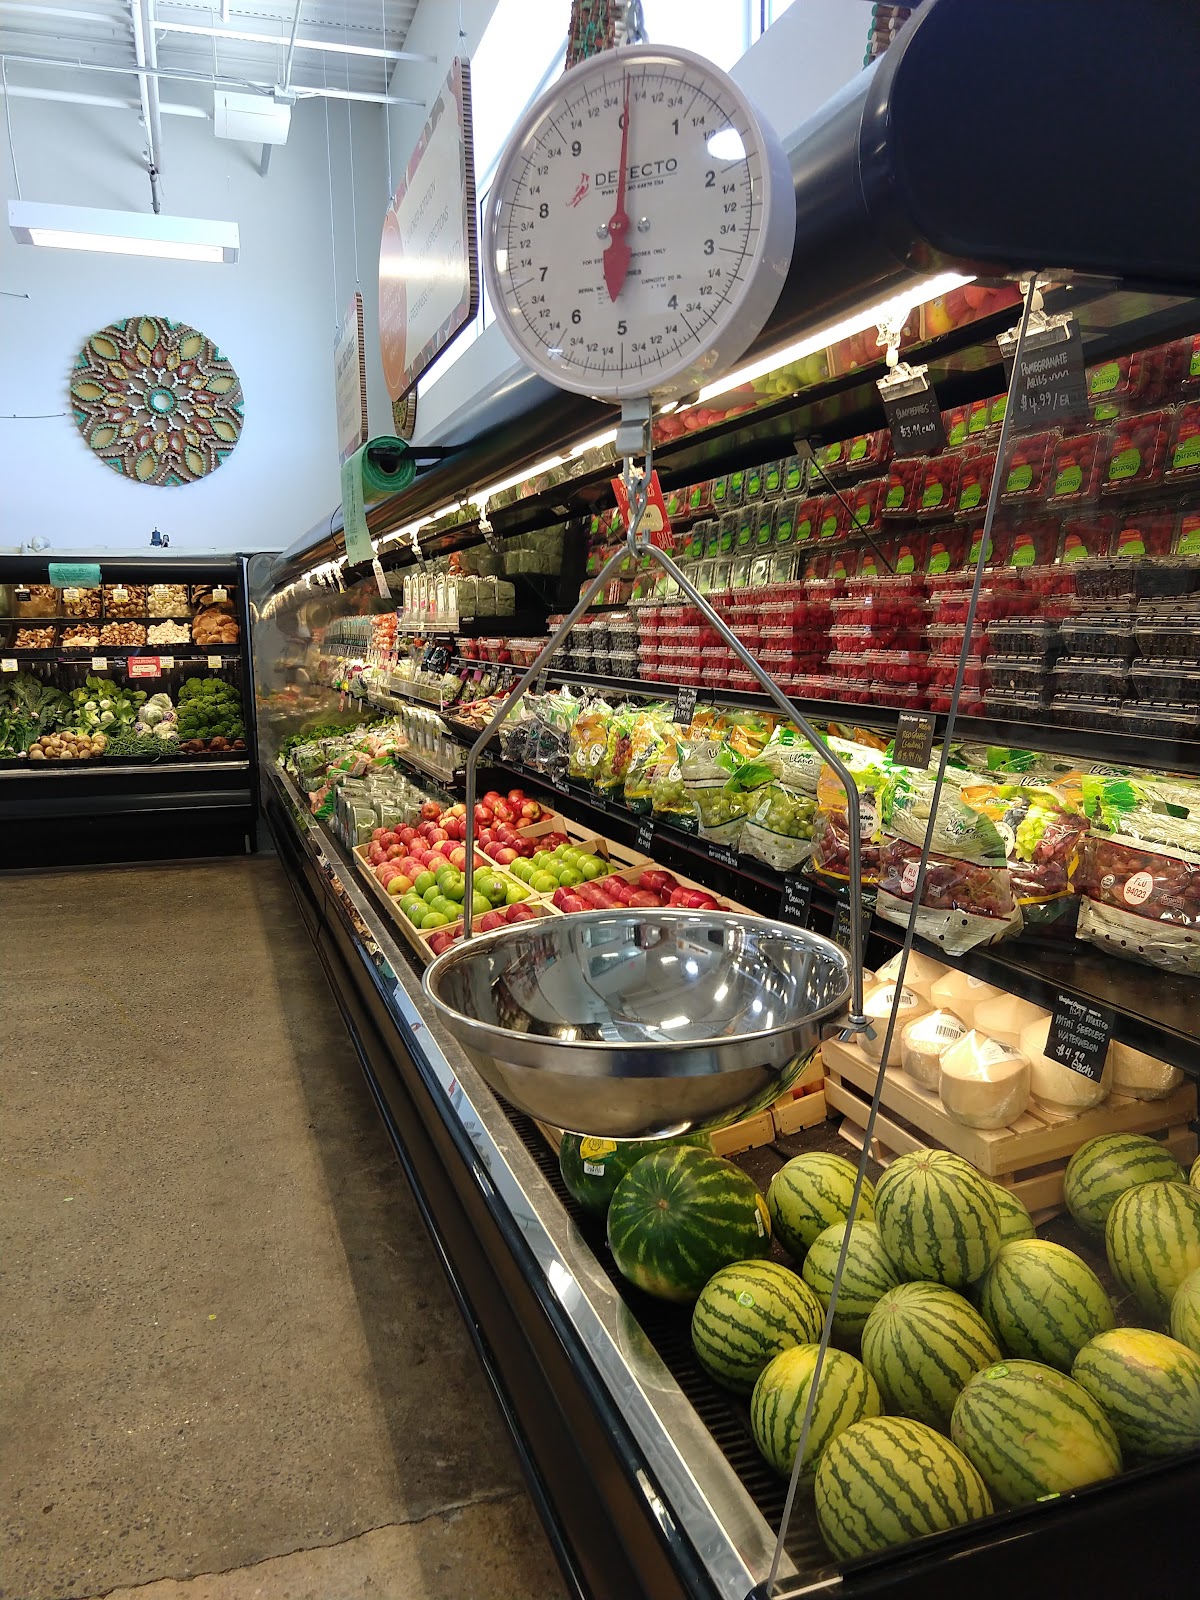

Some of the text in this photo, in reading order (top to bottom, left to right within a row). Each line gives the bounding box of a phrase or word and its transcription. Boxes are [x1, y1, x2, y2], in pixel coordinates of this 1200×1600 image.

[634, 91, 647, 101] 1/4
[652, 92, 664, 103] 1/2
[604, 97, 618, 108] 3/4
[668, 96, 683, 108] 3/4
[588, 107, 600, 118] 1/2
[571, 120, 582, 130] 1/4
[672, 119, 679, 135] 1
[692, 116, 704, 127] 1/4
[548, 147, 561, 158] 3/4
[571, 140, 582, 157] 9
[537, 165, 549, 175] 1/2
[705, 170, 716, 188] 2
[529, 186, 540, 195] 1/4
[722, 183, 736, 194] 1/4
[539, 203, 549, 218] 8
[723, 202, 737, 213] 1/2
[521, 222, 534, 232] 3/4
[720, 223, 736, 234] 3/4
[520, 239, 532, 249] 1/2
[703, 239, 715, 255] 3
[521, 258, 532, 268] 1/4
[539, 266, 549, 282] 7
[708, 268, 721, 278] 1/4
[700, 285, 713, 296] 1/2
[531, 294, 545, 304] 3/4
[667, 294, 679, 311] 4
[539, 308, 551, 318] 1/2
[686, 302, 702, 313] 3/4
[571, 308, 582, 325] 6
[549, 321, 560, 331] 1/4
[617, 320, 628, 336] 5
[665, 325, 678, 334] 1/4
[570, 336, 584, 347] 3/4
[650, 335, 662, 345] 1/2
[586, 343, 599, 352] 1/2
[602, 346, 614, 356] 1/4
[631, 343, 646, 353] 3/4
[1021, 352, 1067, 376] POMEGRANATE
[657, 532, 675, 549] SALE
[1126, 886, 1147, 899] 94023
[1076, 1023, 1106, 1042] SEEDLESS
[1058, 1029, 1099, 1052] WATERMELON
[1056, 1043, 1086, 1062] $4.99
[1071, 1058, 1094, 1078] each
